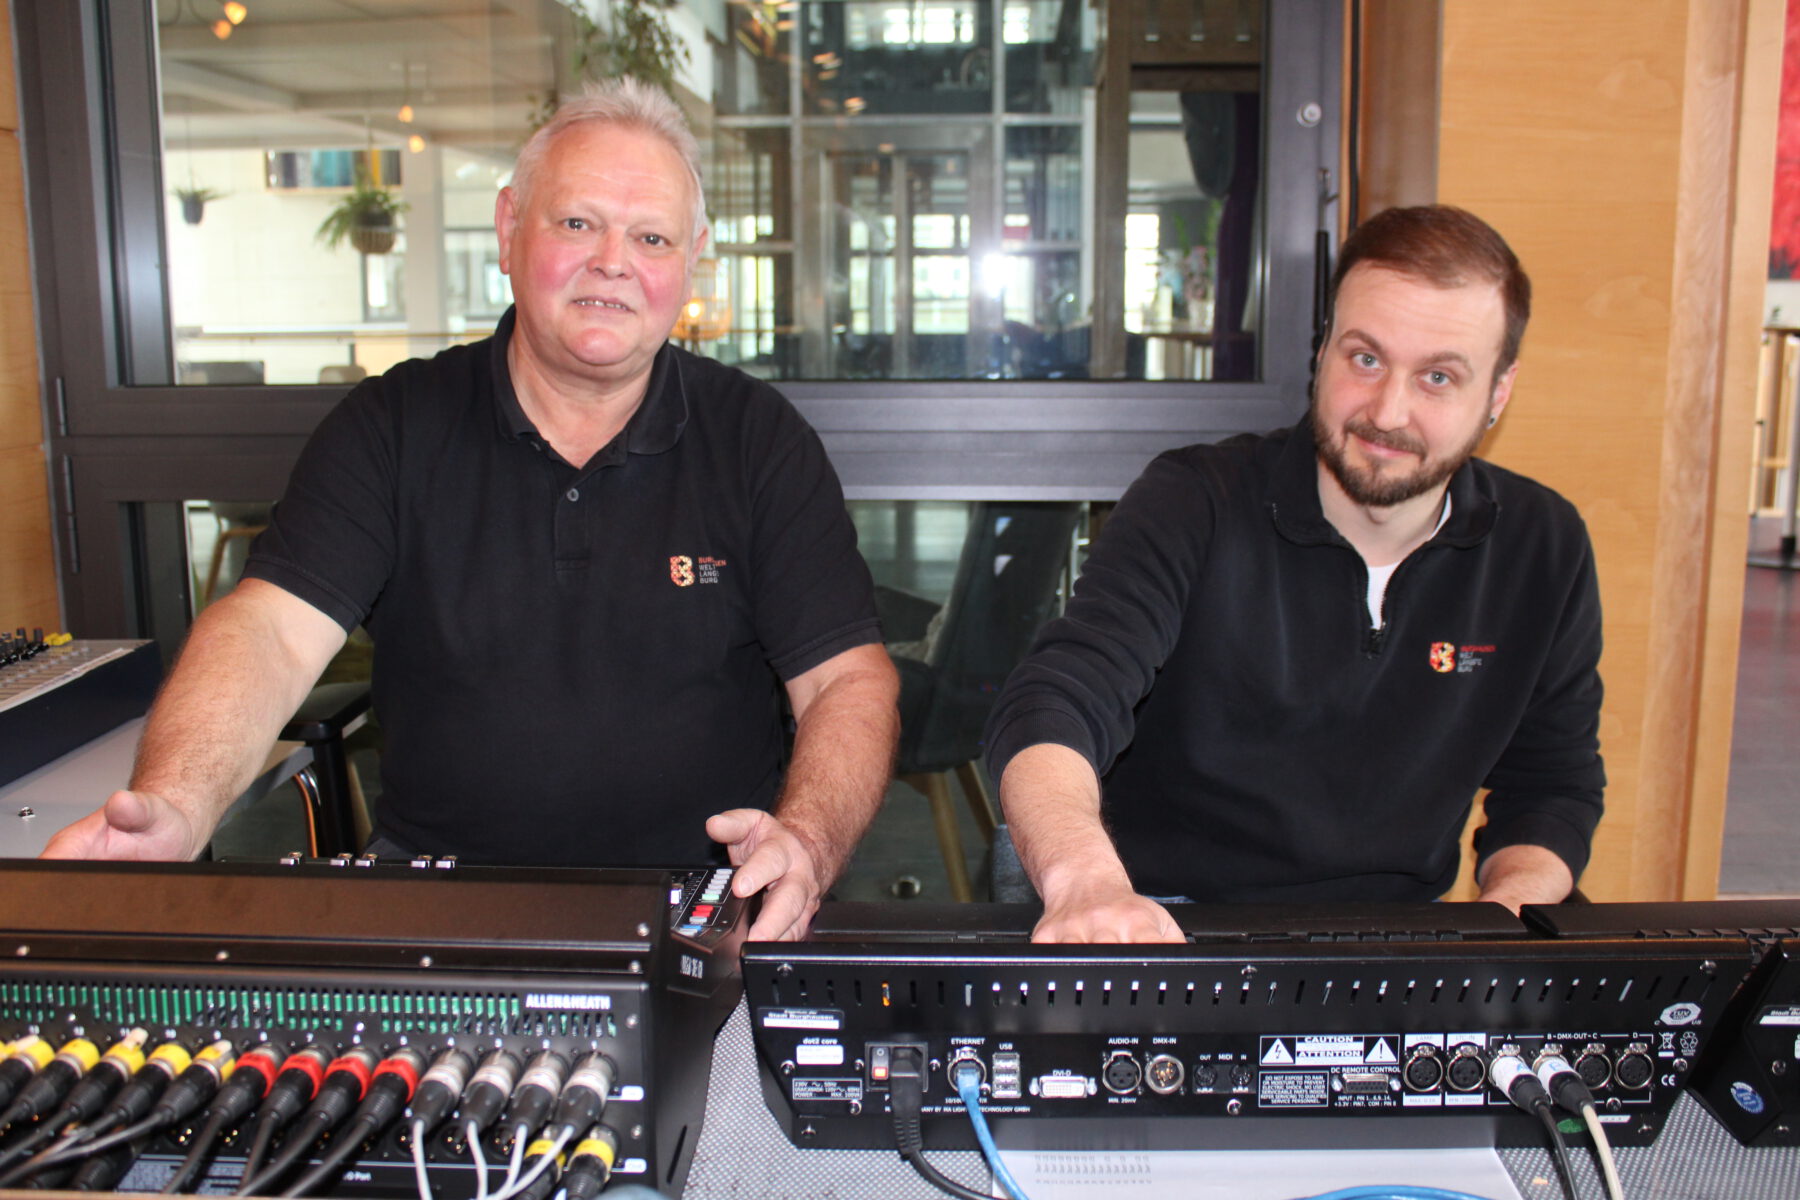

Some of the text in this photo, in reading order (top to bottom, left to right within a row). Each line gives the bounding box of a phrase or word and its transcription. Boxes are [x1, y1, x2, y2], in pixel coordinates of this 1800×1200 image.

[525, 993, 612, 1010] ALLEN&HEATH
[950, 1037, 986, 1045] ETHERNET
[1108, 1037, 1139, 1045] AUDIO-IN
[1152, 1037, 1177, 1045] DMX-IN
[1304, 1036, 1354, 1044] CAUTION
[998, 1042, 1014, 1050] USB
[1218, 1053, 1233, 1061] MIDI
[1298, 1050, 1362, 1058] ATTENTION
[1330, 1065, 1401, 1074] DC REMOTE CONTROL
[1661, 1073, 1676, 1086] CE
